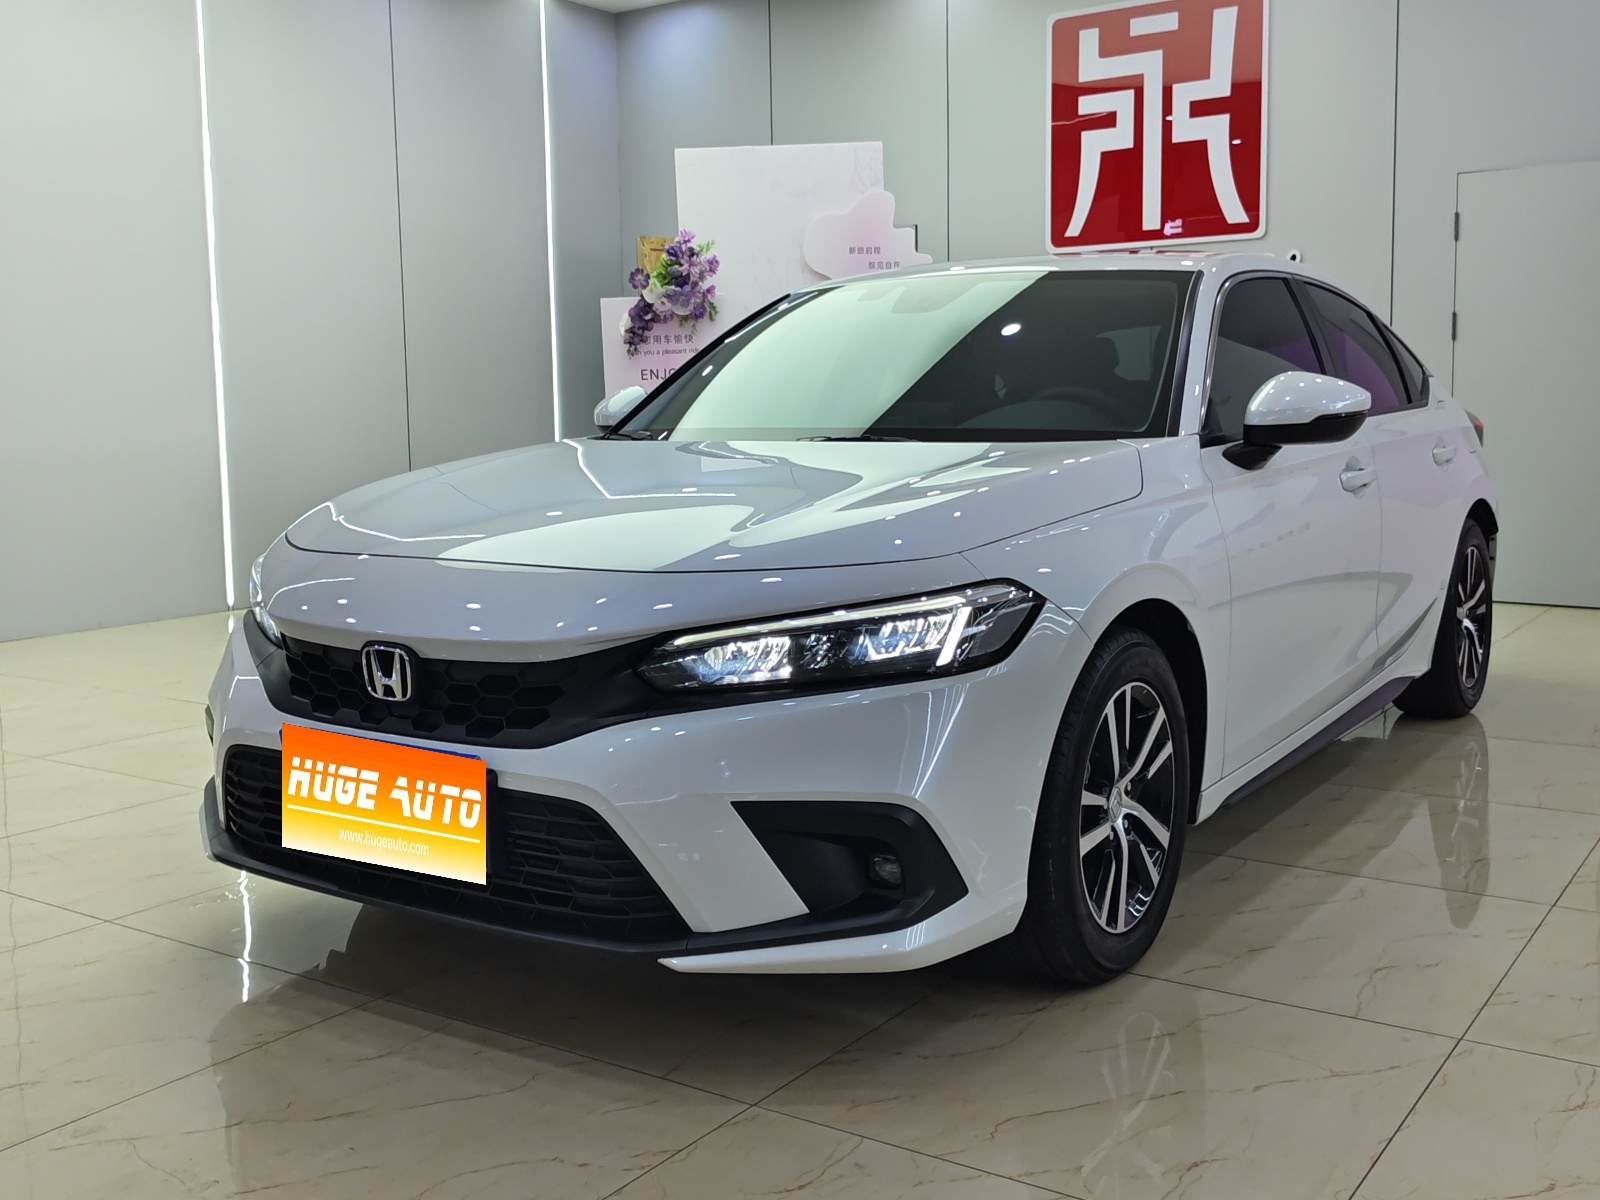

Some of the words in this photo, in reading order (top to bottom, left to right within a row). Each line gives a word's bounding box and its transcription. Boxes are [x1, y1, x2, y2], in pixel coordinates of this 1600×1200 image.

[849, 246, 881, 255] 新旅启程
[662, 347, 687, 356] pleasant
